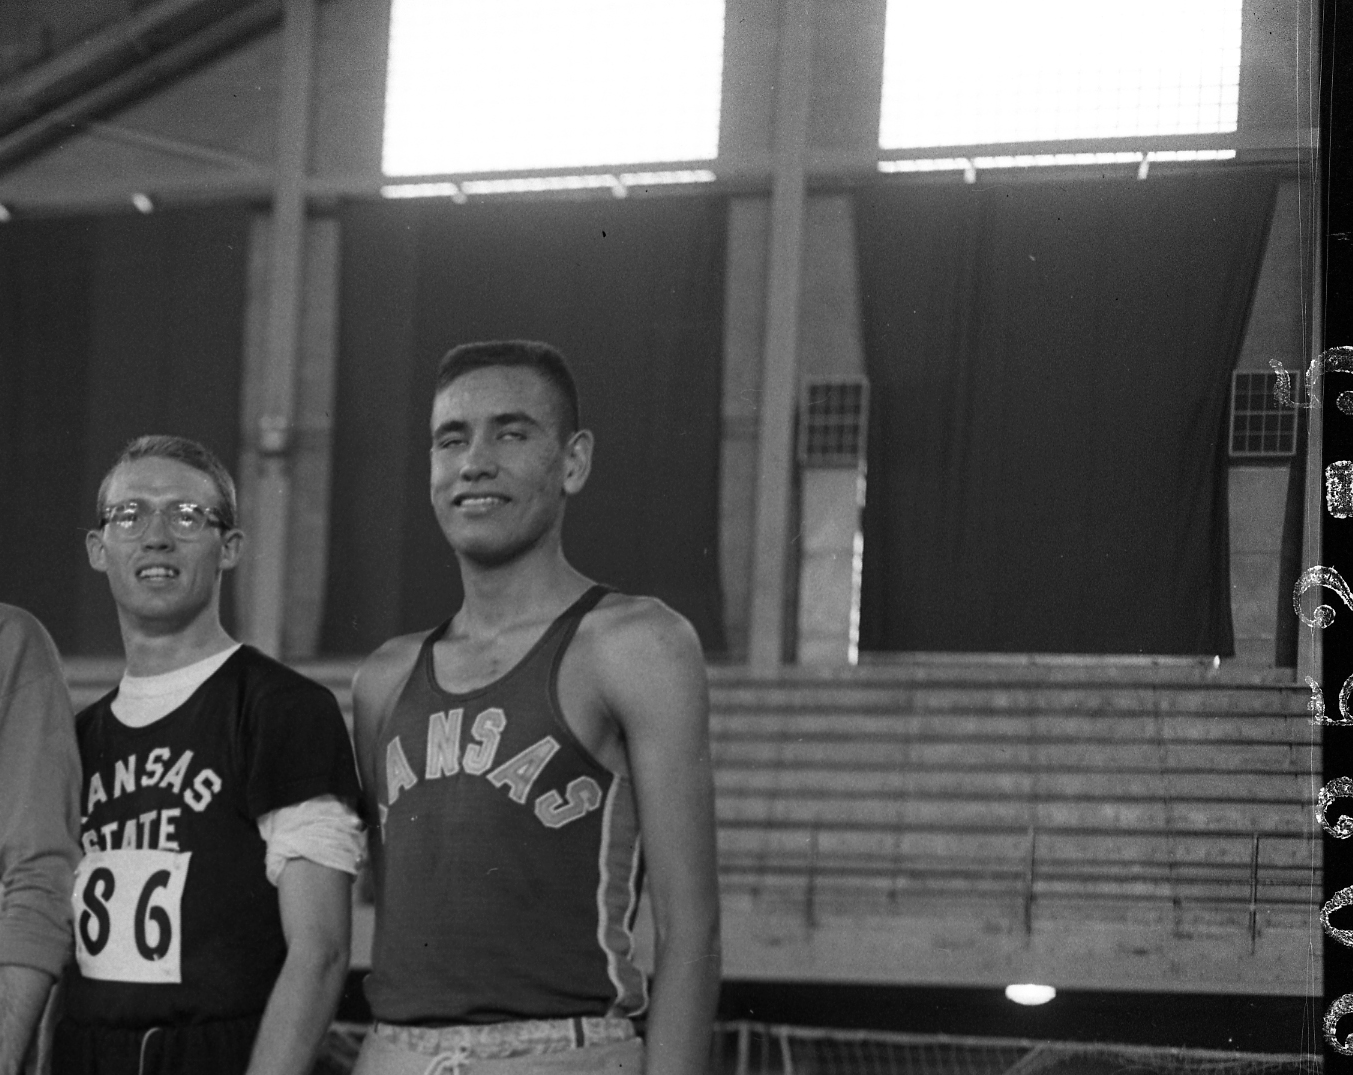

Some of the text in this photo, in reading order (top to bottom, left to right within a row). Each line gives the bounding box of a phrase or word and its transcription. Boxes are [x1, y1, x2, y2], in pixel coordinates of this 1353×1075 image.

[81, 747, 222, 824] ANSAS
[378, 707, 602, 844] ANSAS
[79, 866, 172, 961] 86
